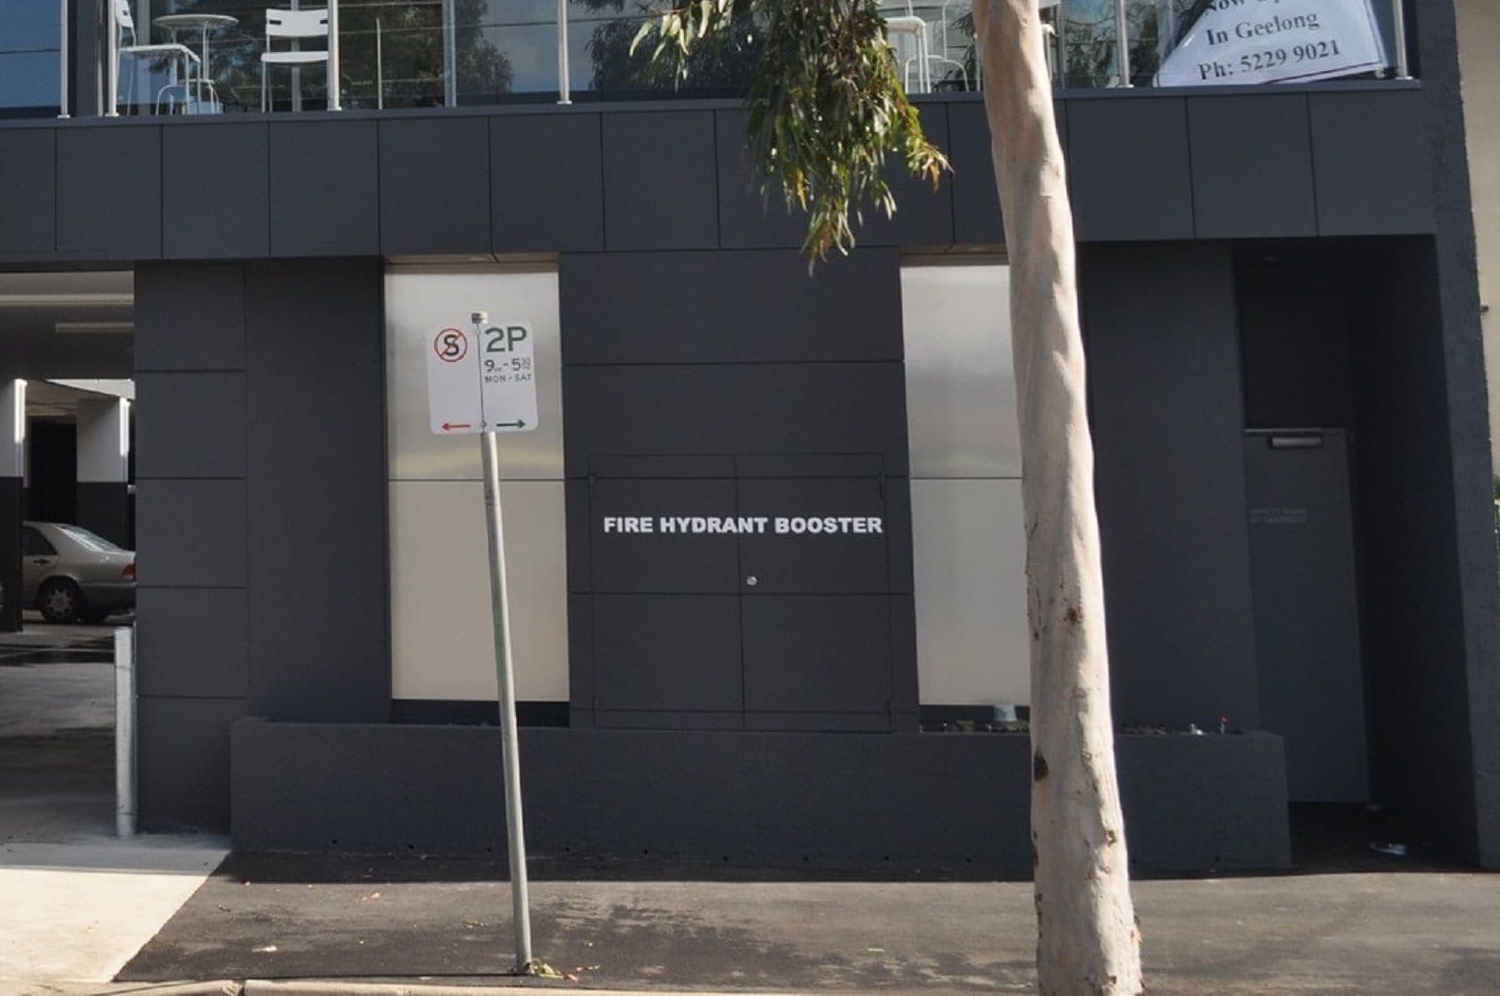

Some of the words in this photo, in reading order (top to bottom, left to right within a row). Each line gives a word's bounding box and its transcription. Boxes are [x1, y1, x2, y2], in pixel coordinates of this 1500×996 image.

[1205, 27, 1229, 46] In
[1235, 12, 1320, 40] Geelong
[1198, 58, 1234, 81] Ph:
[1240, 47, 1287, 73] 5229
[1291, 39, 1341, 62] 9021
[485, 326, 528, 353] 2P
[514, 373, 532, 382] SAT
[603, 516, 654, 534] FIRE
[659, 516, 768, 534] HYDRANT
[774, 516, 884, 534] BOOSTER
